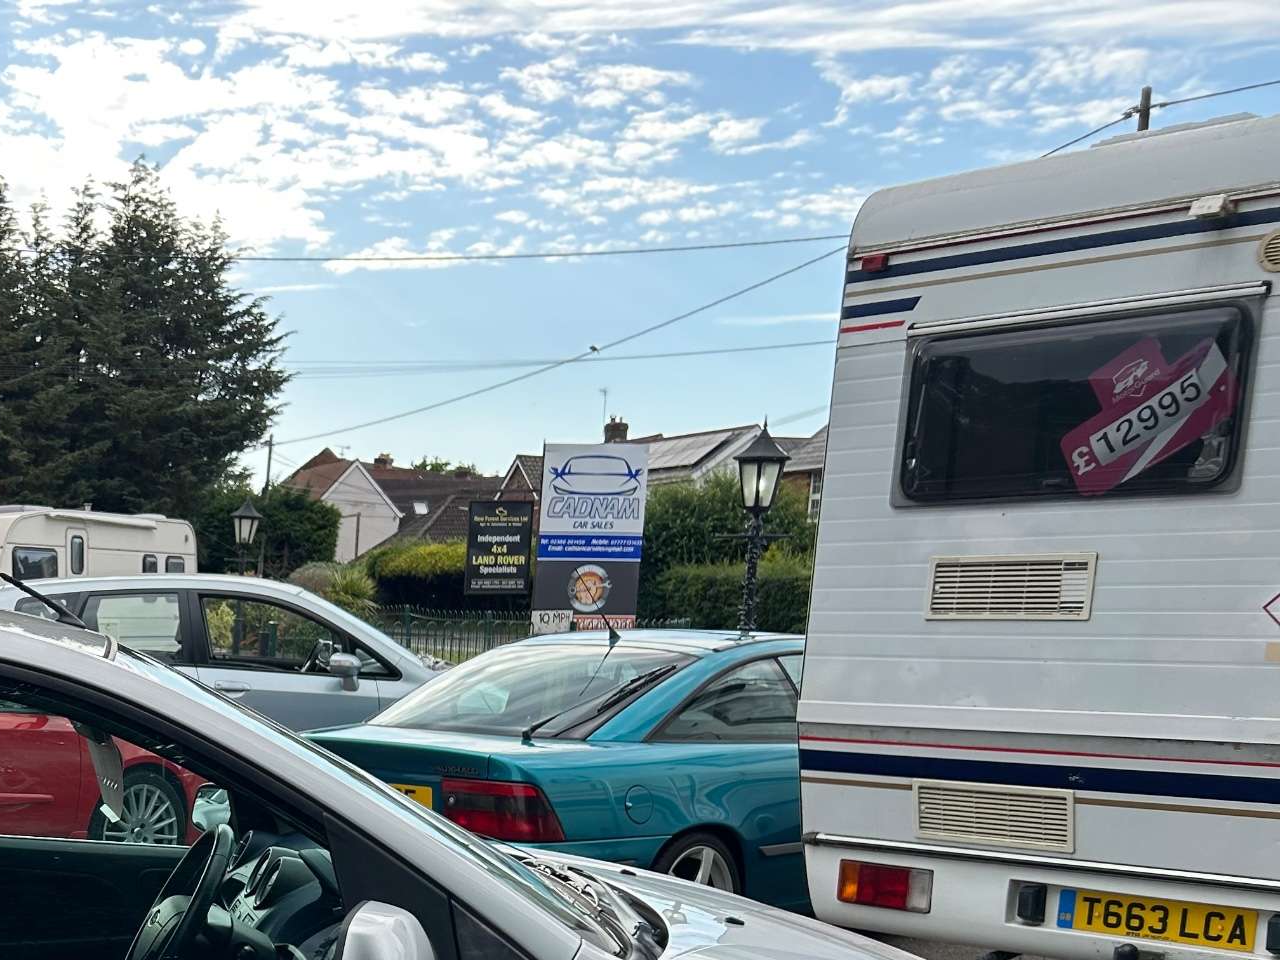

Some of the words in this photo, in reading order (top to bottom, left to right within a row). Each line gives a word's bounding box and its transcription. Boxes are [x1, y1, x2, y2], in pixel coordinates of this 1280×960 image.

[547, 496, 640, 519] CADNAM
[573, 521, 587, 529] CAR
[590, 521, 614, 529] SALES
[477, 534, 521, 544] Independent
[491, 544, 508, 554] 4x4
[472, 555, 495, 565] LAND
[497, 555, 526, 566] ROVER
[480, 565, 517, 575] Specialists
[552, 613, 570, 624] MPH
[1083, 897, 1169, 934] T663
[1178, 908, 1247, 946] LCA
